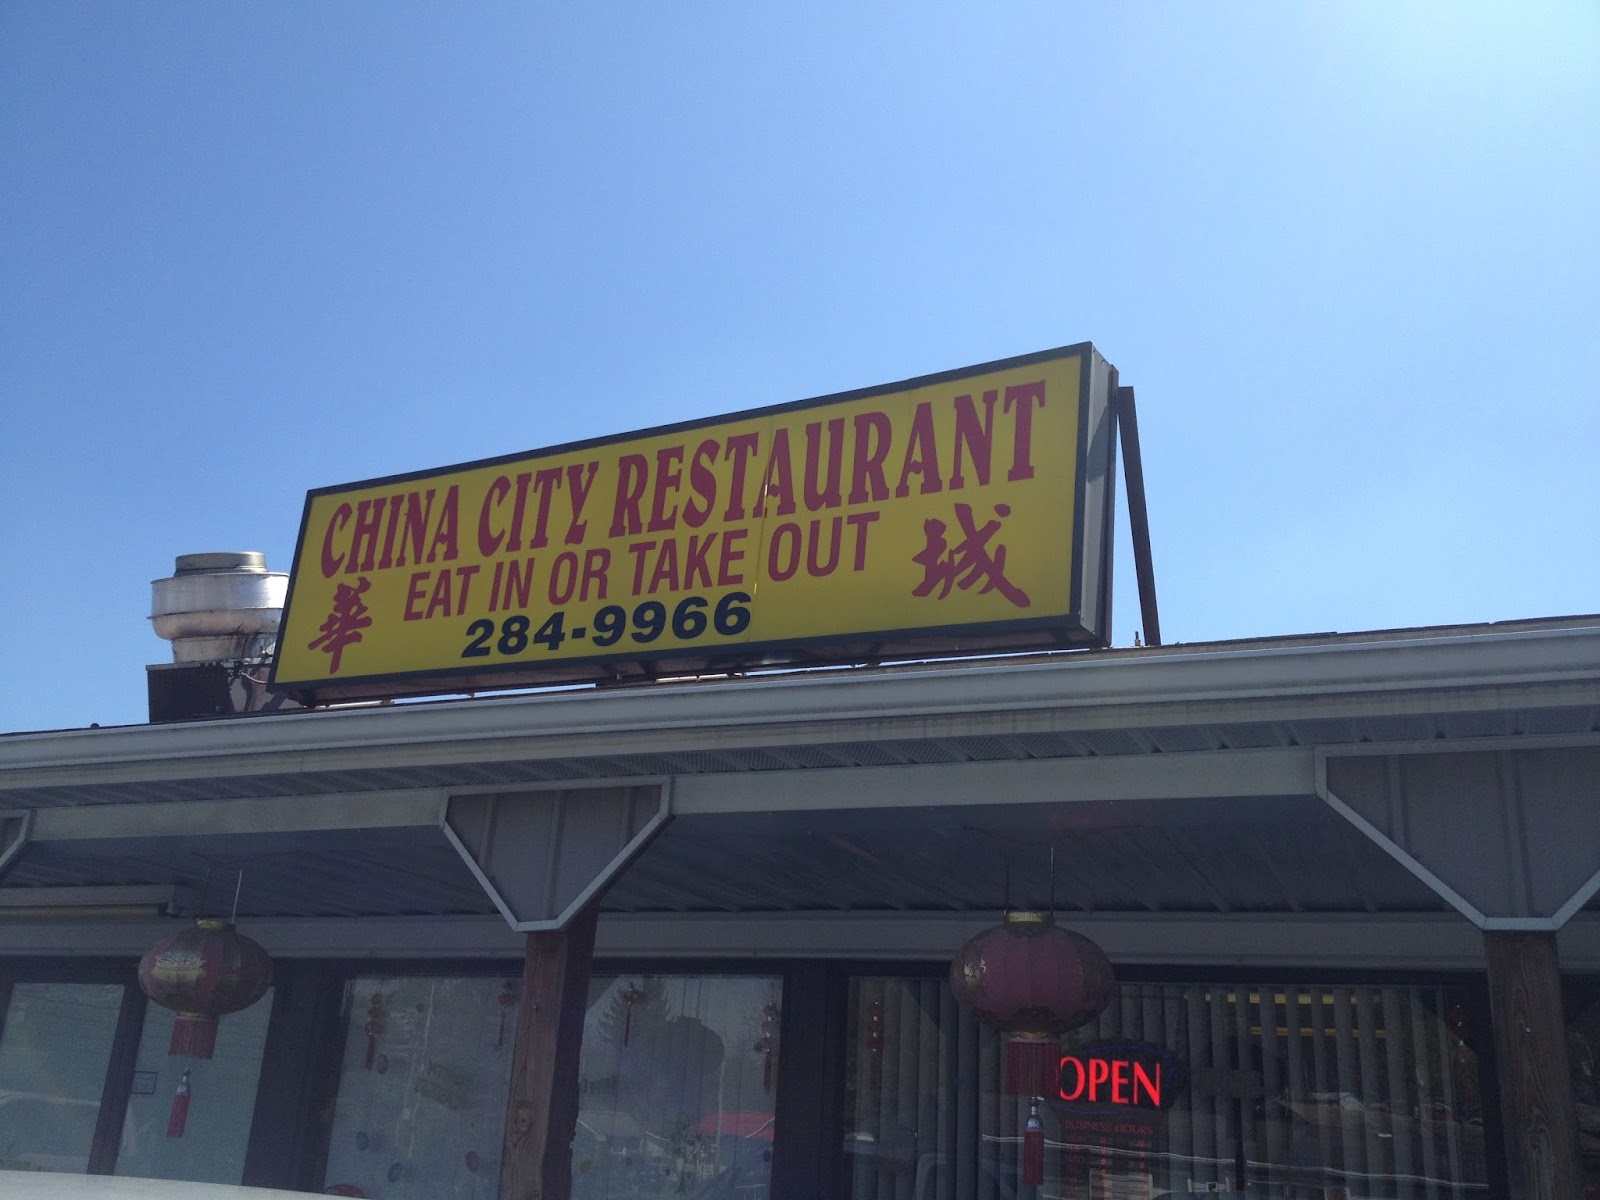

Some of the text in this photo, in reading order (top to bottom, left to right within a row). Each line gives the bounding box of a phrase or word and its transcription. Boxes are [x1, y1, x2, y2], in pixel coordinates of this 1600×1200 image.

[321, 379, 1046, 578] CHINA CITY RESTAURANT
[403, 511, 880, 621] EAT IN OR TAKE OUT
[912, 503, 1031, 608] 城
[308, 576, 373, 674] 華
[461, 591, 752, 658] 284-9966
[1060, 1056, 1161, 1107] OPEN
[1065, 1119, 1110, 1132] BUSINESS
